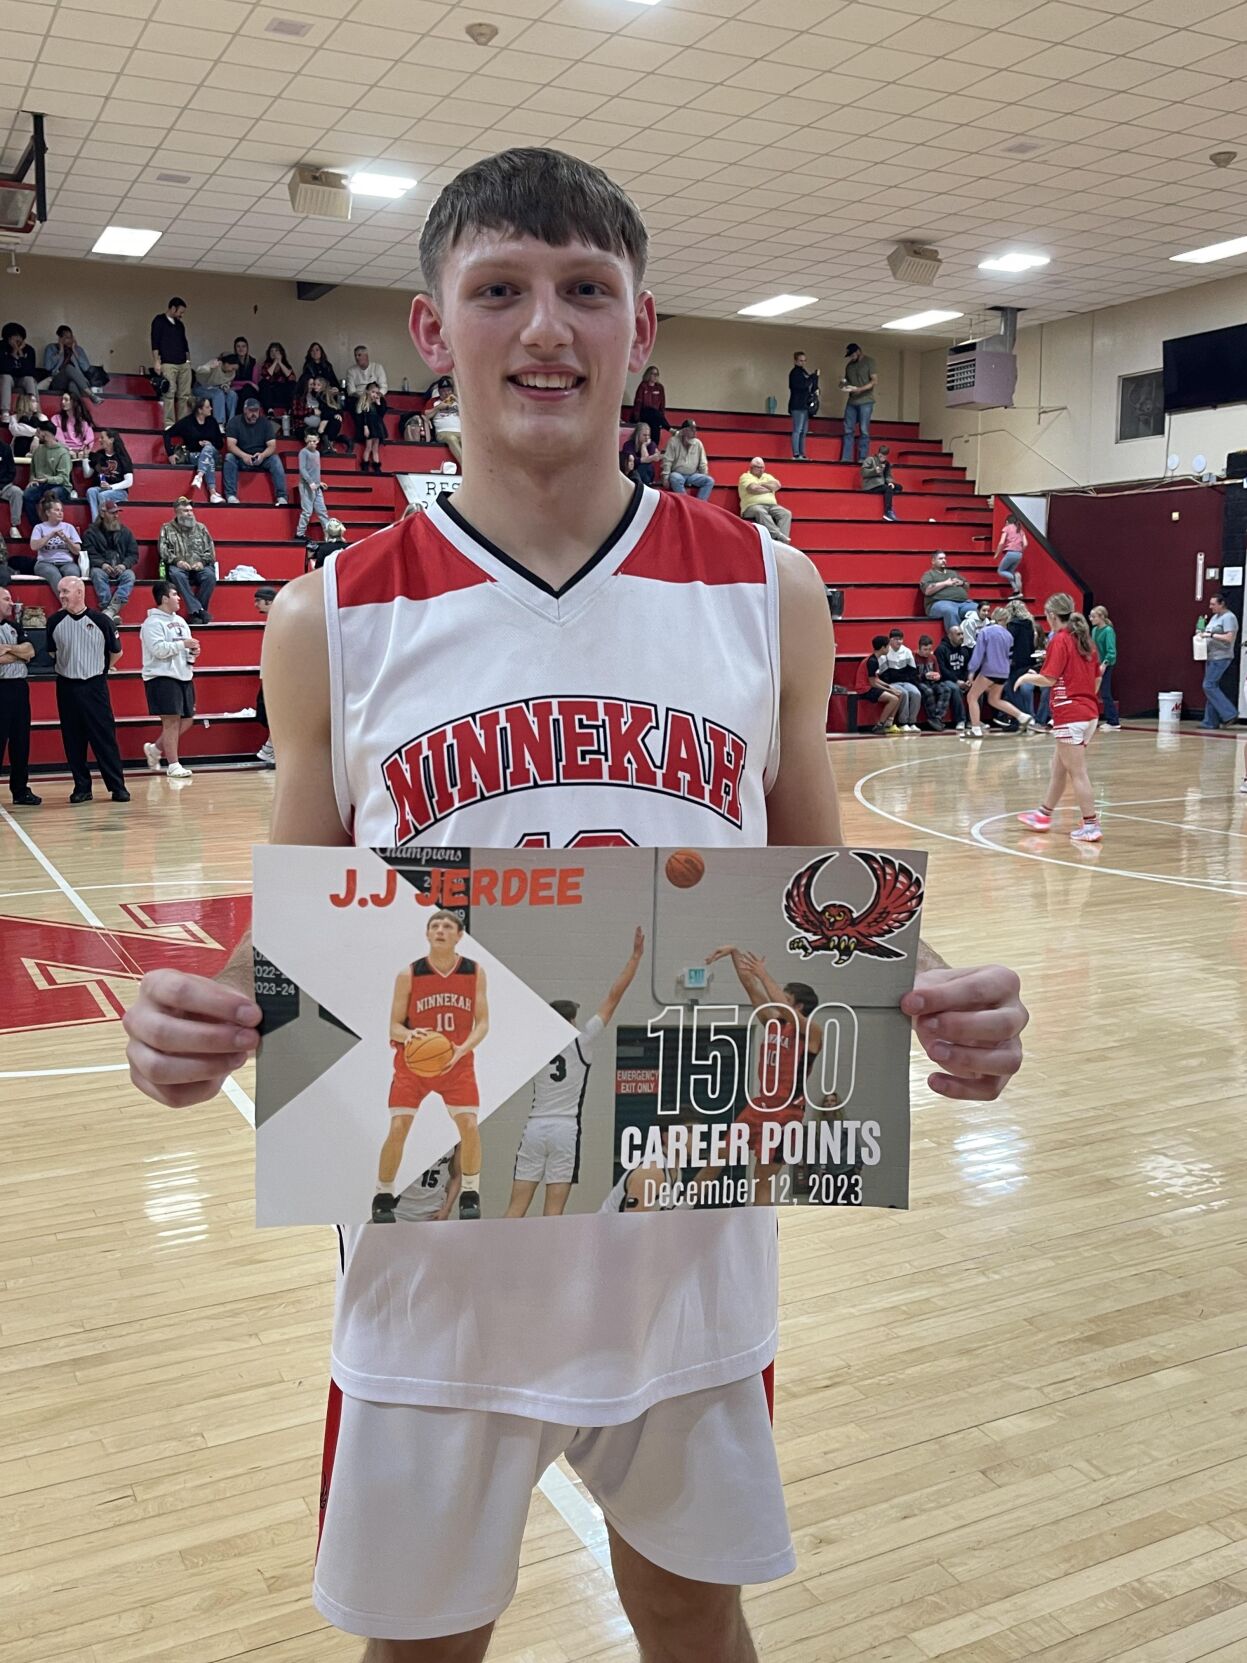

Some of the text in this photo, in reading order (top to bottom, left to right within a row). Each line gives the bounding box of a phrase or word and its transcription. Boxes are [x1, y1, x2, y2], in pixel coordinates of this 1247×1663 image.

[381, 694, 748, 847] NINNEKAH
[329, 867, 585, 908] J.J JERDEE
[254, 965, 289, 979] 022-
[254, 981, 296, 996] 023-24
[416, 993, 472, 1013] NINNEKAH
[436, 1012, 456, 1032] 10
[549, 1054, 567, 1082] 3
[647, 1002, 859, 1115] 1500
[616, 1070, 659, 1081] EMERGENCY
[620, 1082, 656, 1093] EXIT ONLY
[620, 1120, 882, 1170] CAREER POINTS
[421, 1169, 441, 1188] 15
[643, 1174, 863, 1208] December 12, 2023
